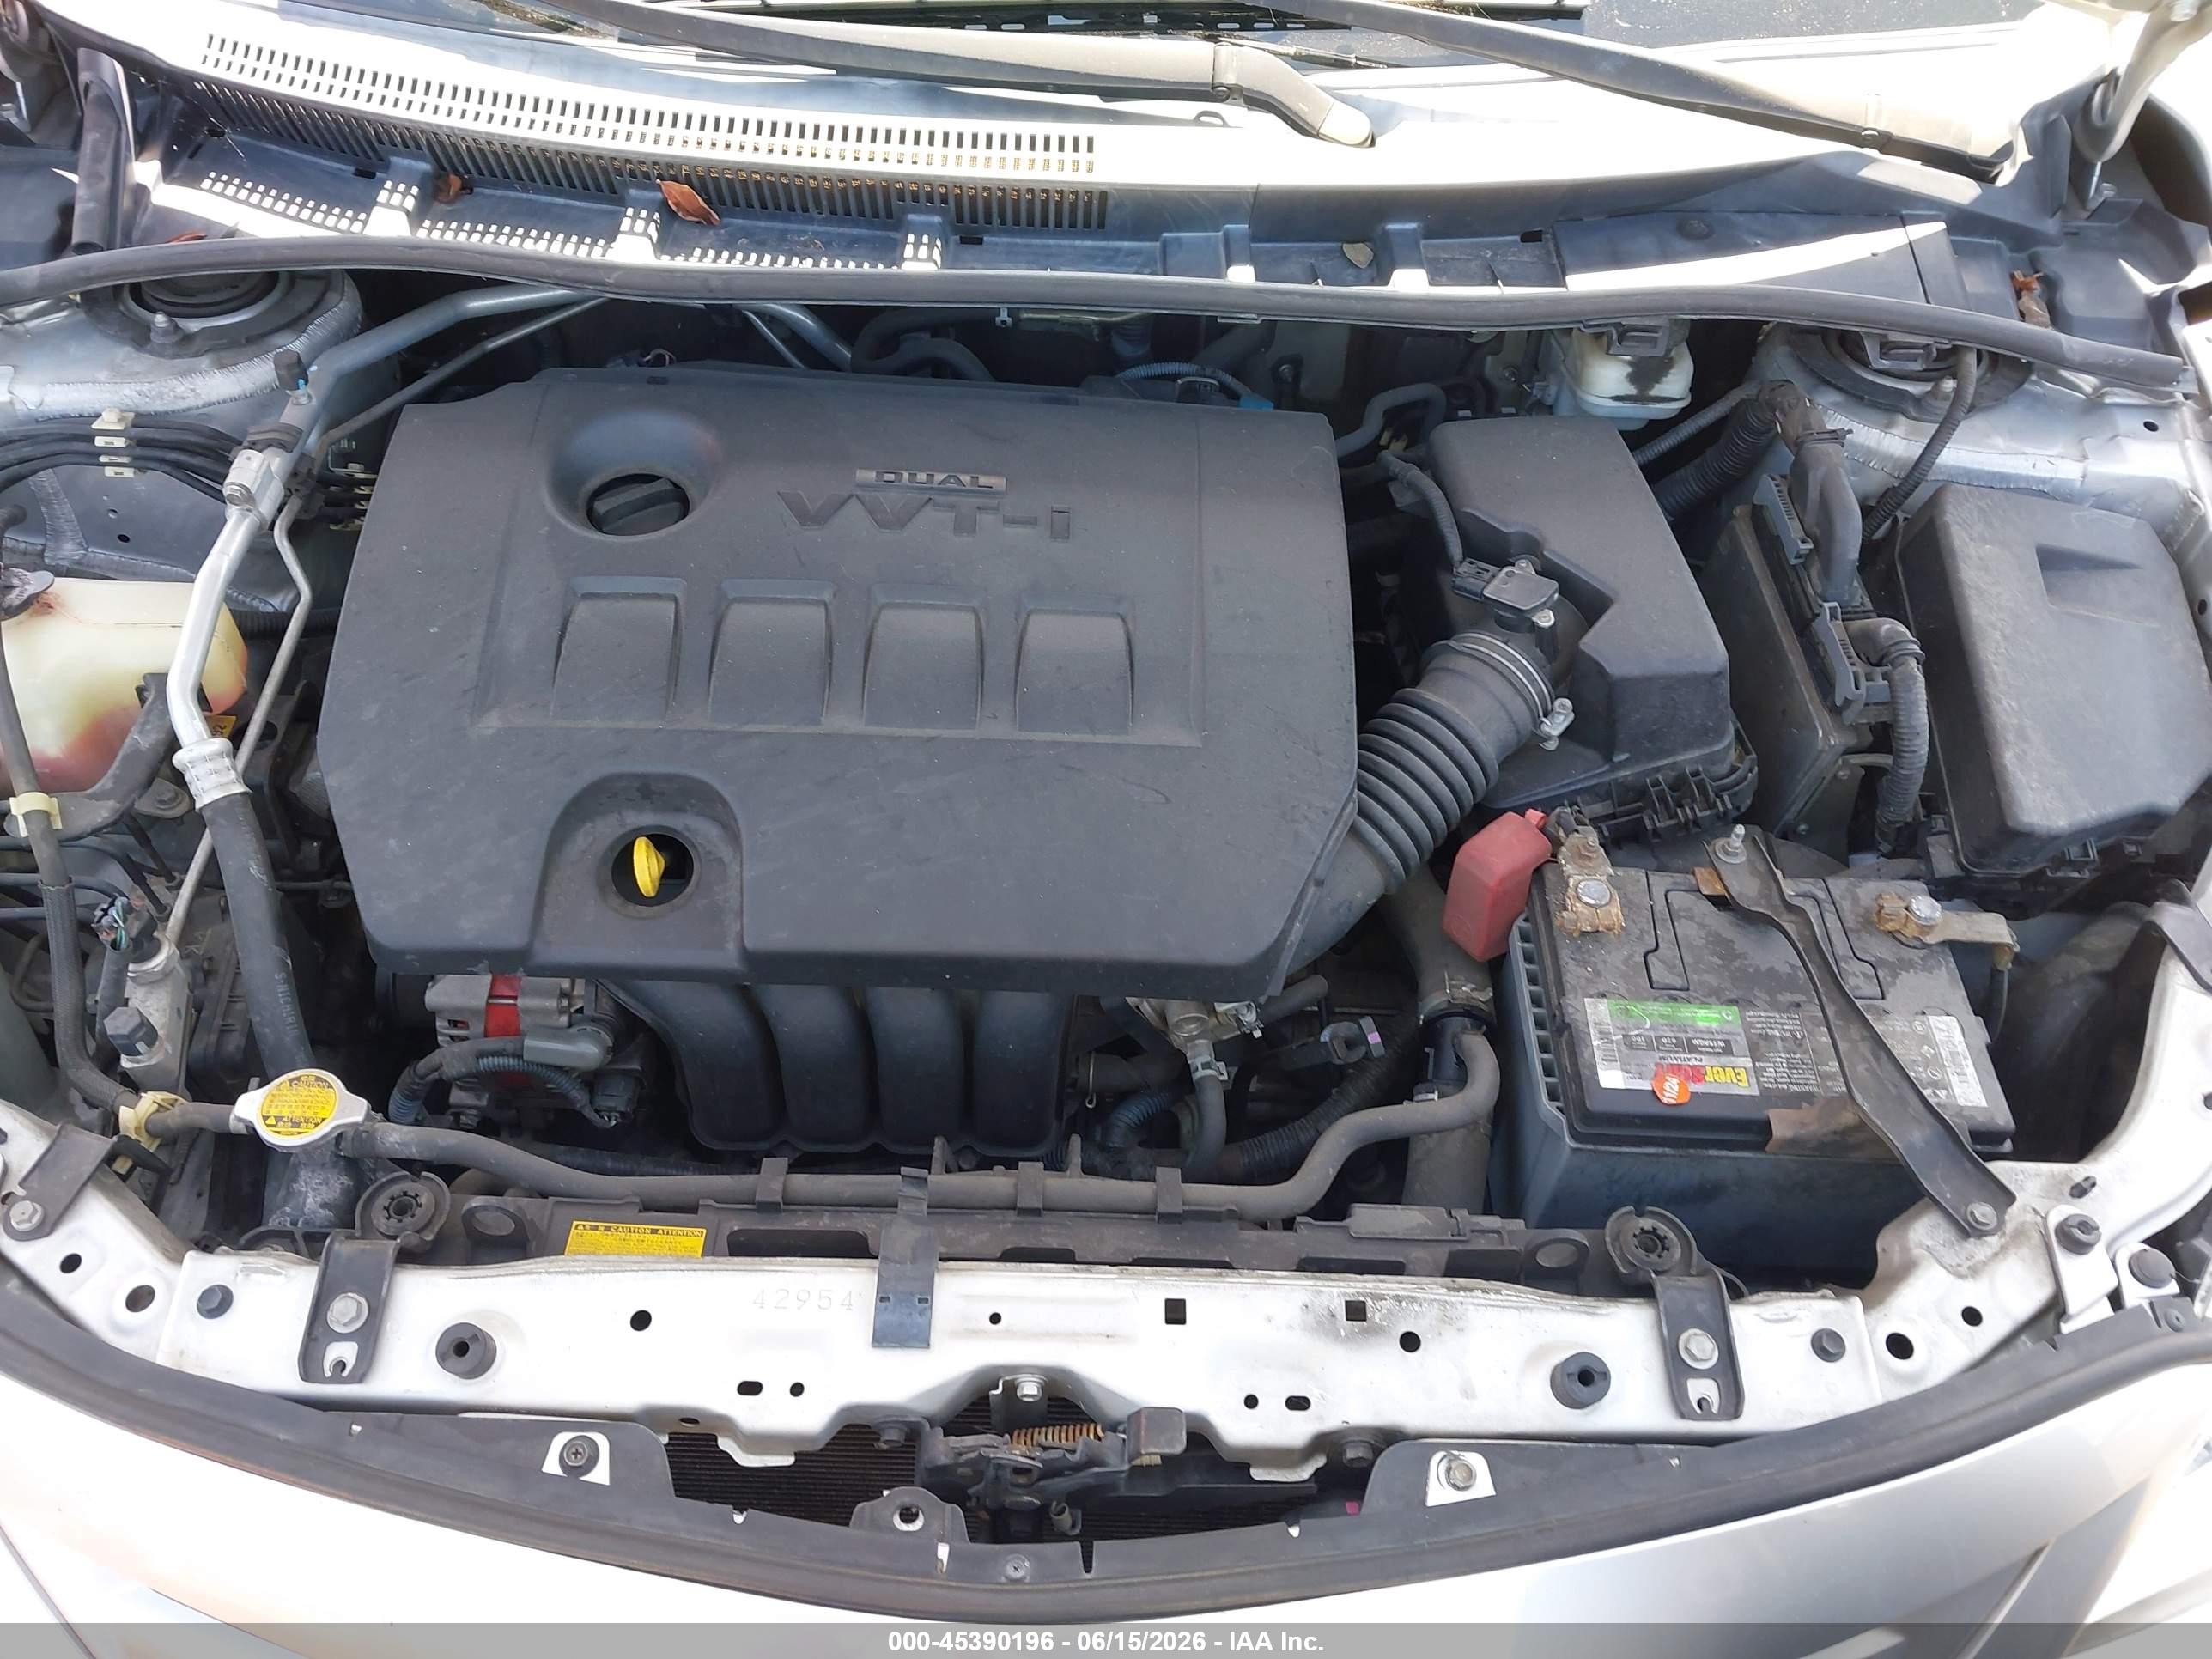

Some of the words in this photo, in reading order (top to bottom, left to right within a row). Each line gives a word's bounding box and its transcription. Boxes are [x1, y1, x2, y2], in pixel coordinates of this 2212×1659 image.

[875, 471, 994, 489] DUAL
[777, 490, 1072, 541] VVT-i
[611, 1225, 651, 1235] CAUTION
[658, 1228, 702, 1237] ATTENTION
[752, 1288, 854, 1311] 42954
